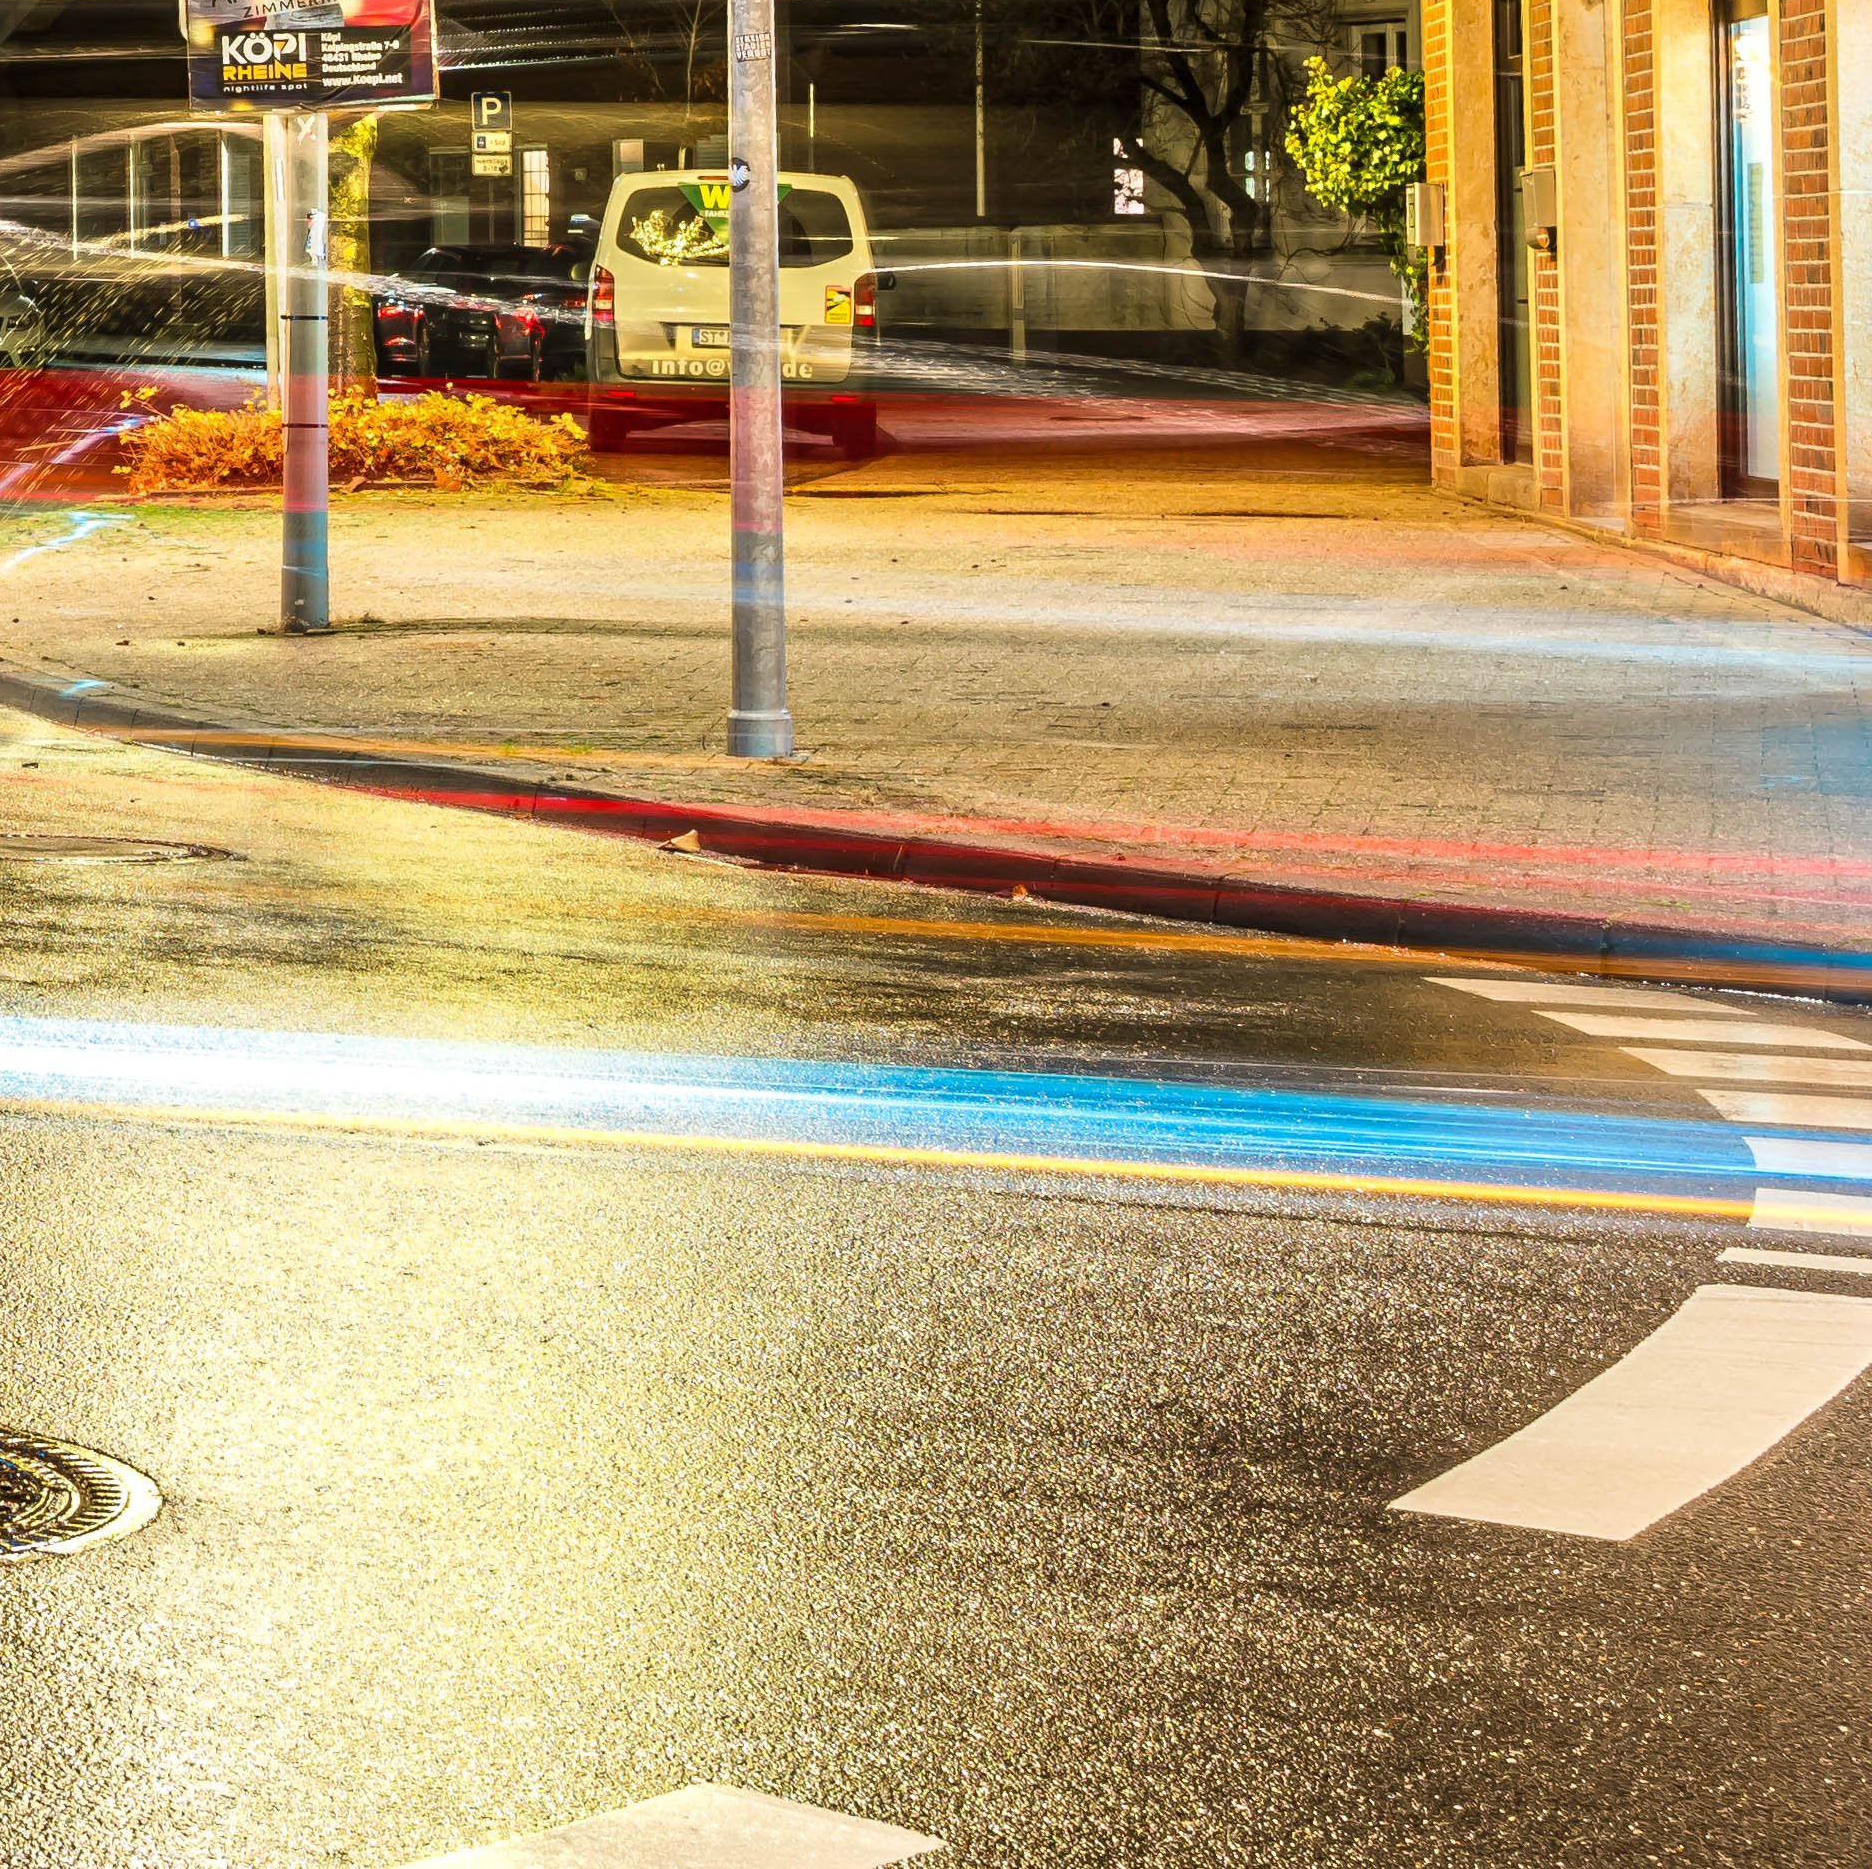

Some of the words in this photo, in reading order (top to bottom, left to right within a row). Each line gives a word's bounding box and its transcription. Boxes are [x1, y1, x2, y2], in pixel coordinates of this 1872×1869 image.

[221, 32, 307, 65] KÖPI
[222, 60, 308, 81] RHEINE
[321, 61, 377, 73] Deutschland
[223, 84, 276, 94] nightlife
[281, 82, 308, 92] spot
[481, 97, 502, 126] P
